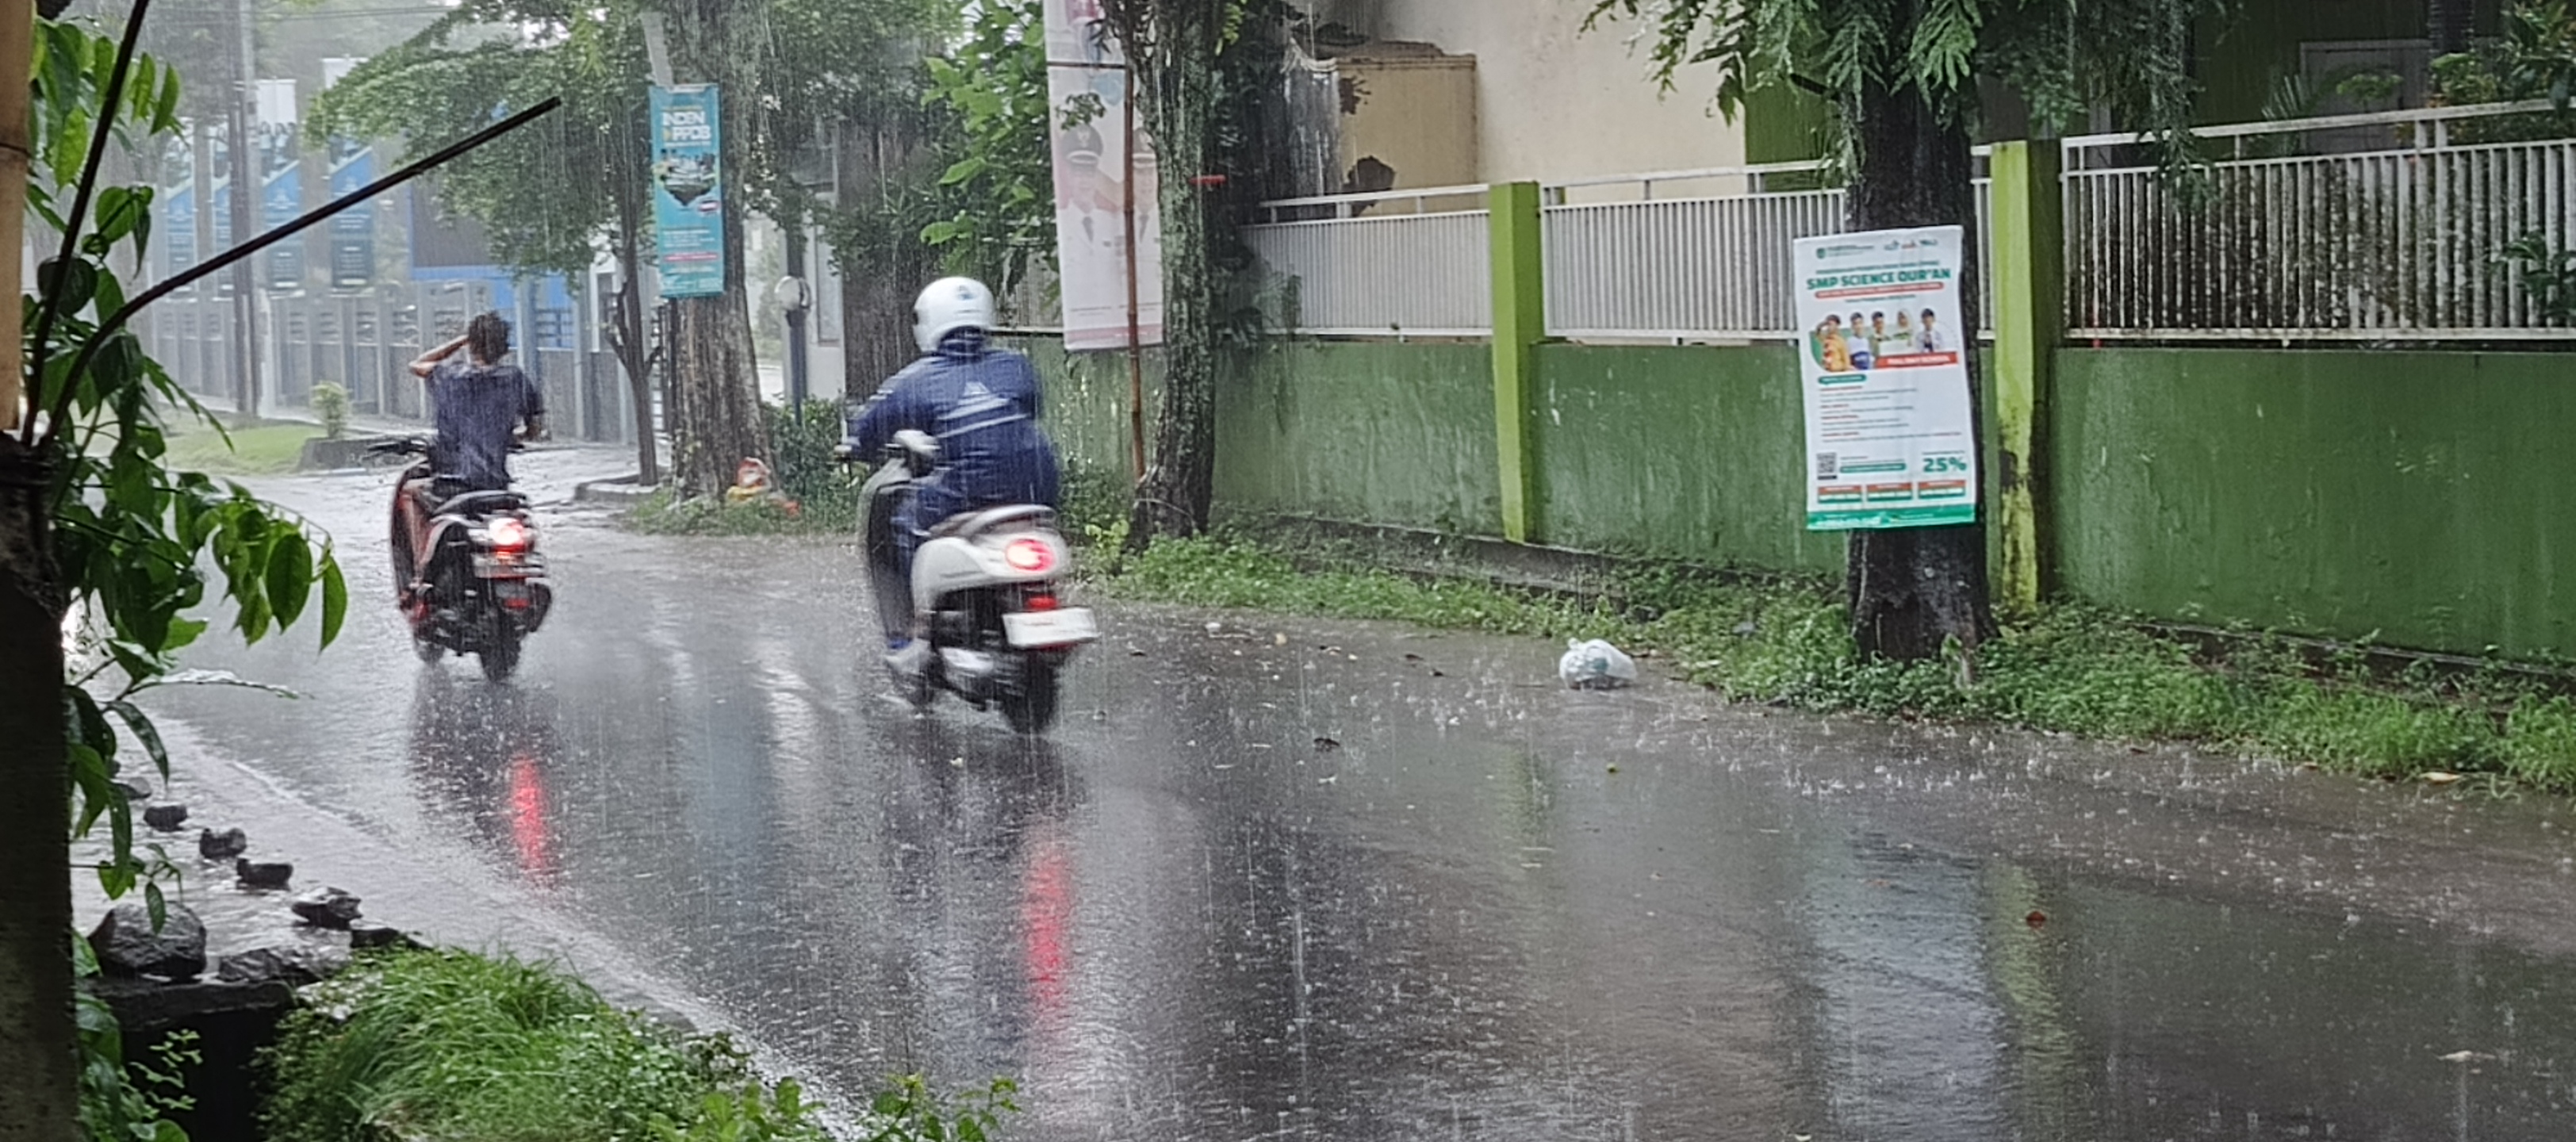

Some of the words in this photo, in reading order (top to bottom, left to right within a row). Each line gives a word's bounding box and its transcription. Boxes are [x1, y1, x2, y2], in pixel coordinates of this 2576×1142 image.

[662, 111, 705, 126] INDEN
[672, 125, 711, 141] PPDB
[1807, 277, 1838, 290] SMP
[1841, 272, 1894, 286] SCIENCE
[1898, 269, 1951, 282] QUR'AN
[1922, 456, 1967, 473] 25%
